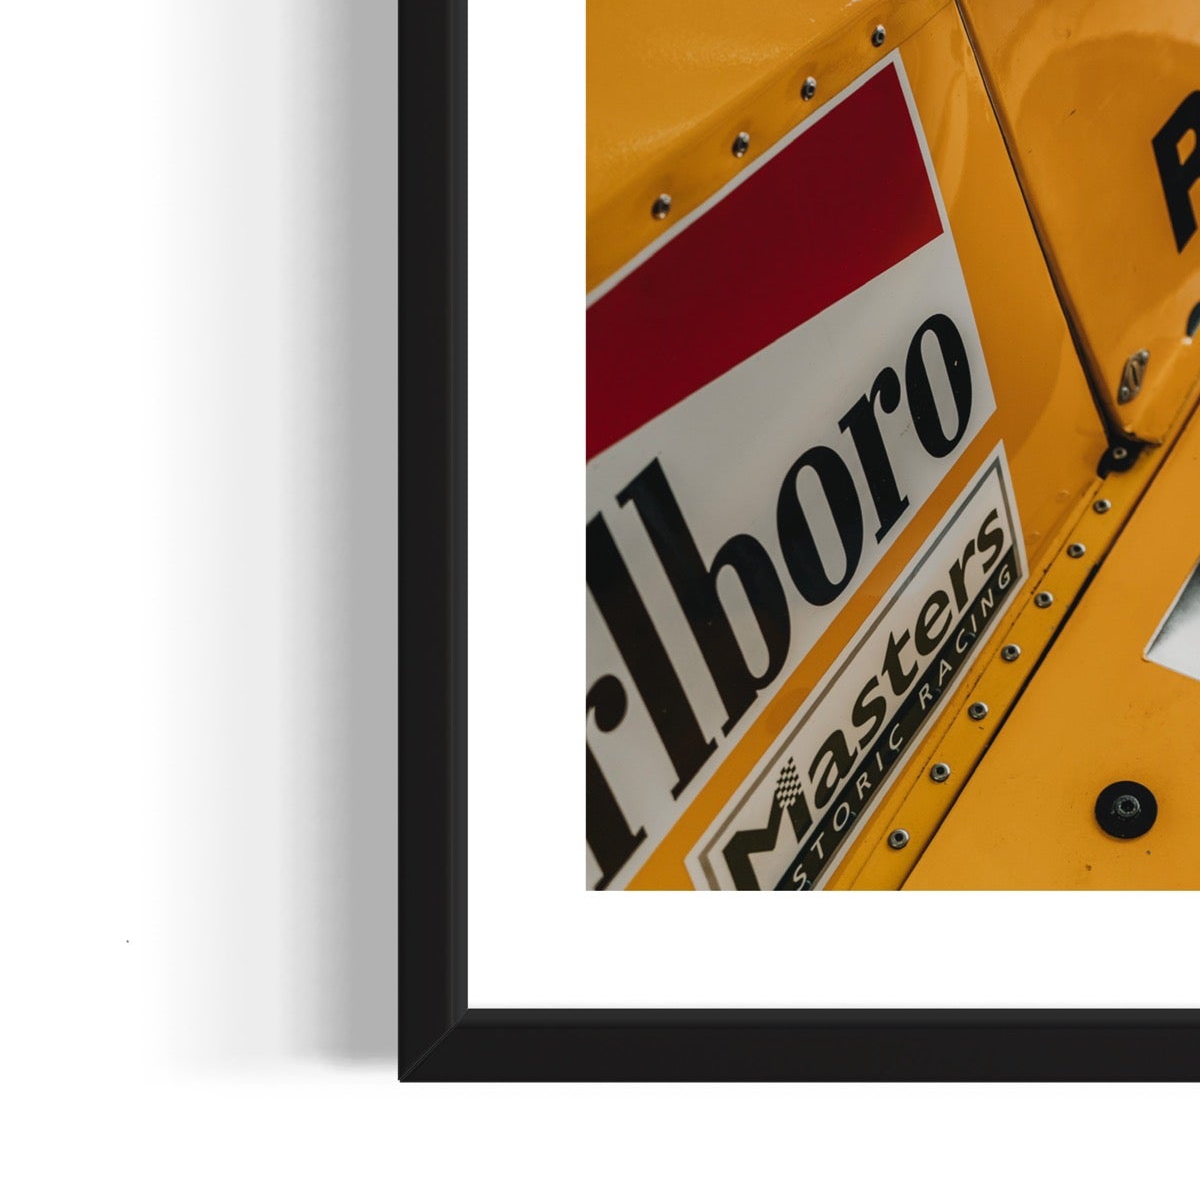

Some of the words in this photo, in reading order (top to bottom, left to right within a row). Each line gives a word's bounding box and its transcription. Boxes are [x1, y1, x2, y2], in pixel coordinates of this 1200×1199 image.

[721, 507, 1004, 890] Masters
[793, 722, 904, 890] STORIC
[918, 563, 1011, 711] RACING
